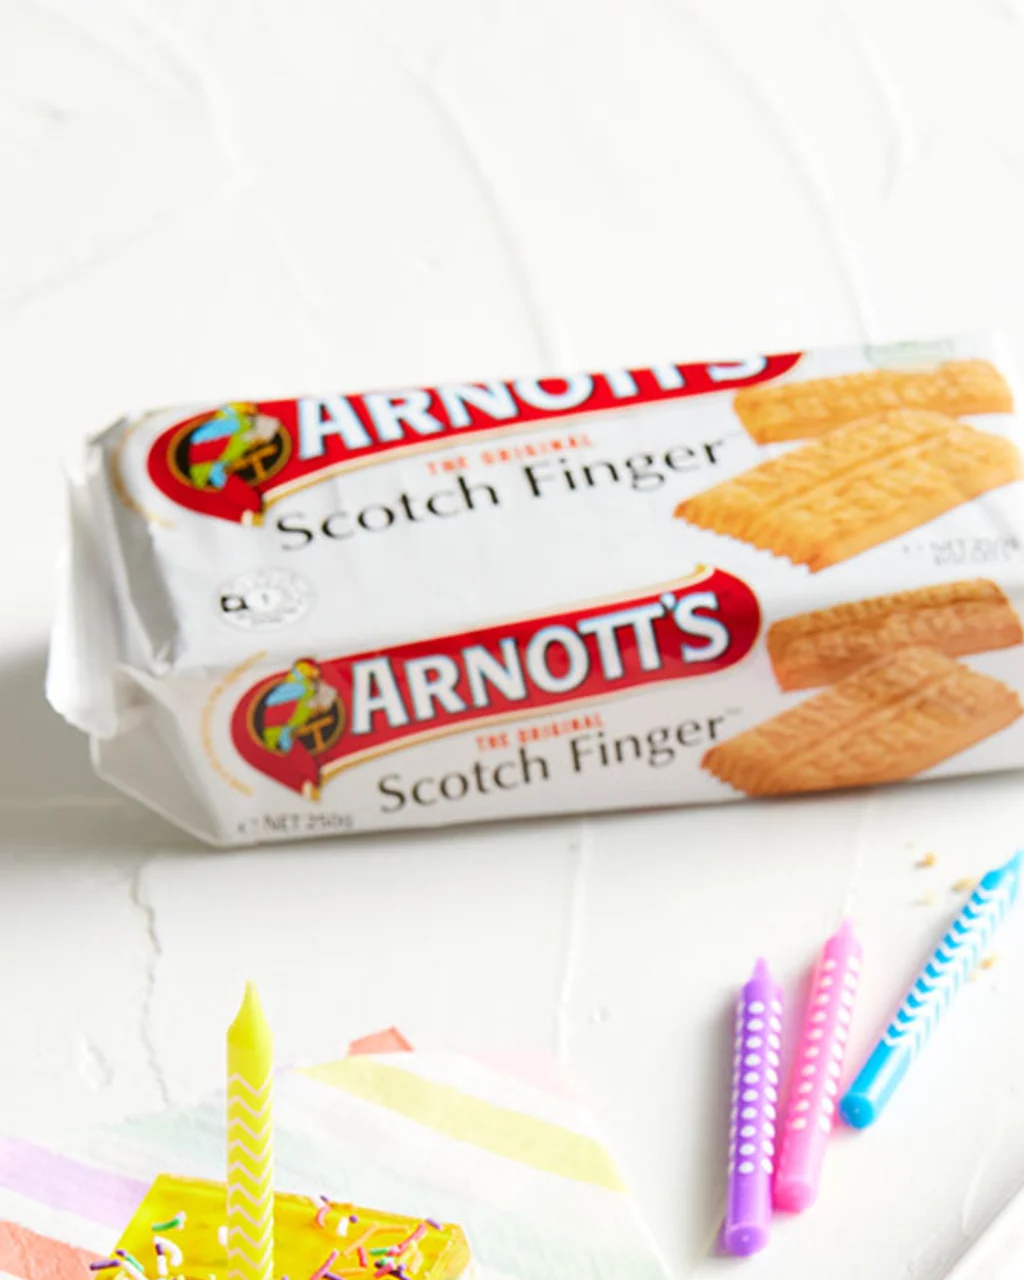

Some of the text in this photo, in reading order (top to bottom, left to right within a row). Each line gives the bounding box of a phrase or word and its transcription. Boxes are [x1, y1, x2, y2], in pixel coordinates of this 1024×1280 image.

[276, 438, 723, 552] Scotch Finger
[426, 433, 592, 477] THE ORIGINAL
[350, 591, 730, 735] ARNOTT'S
[377, 715, 726, 813] Scotch Finger
[476, 713, 604, 751] THE ORIGINAL
